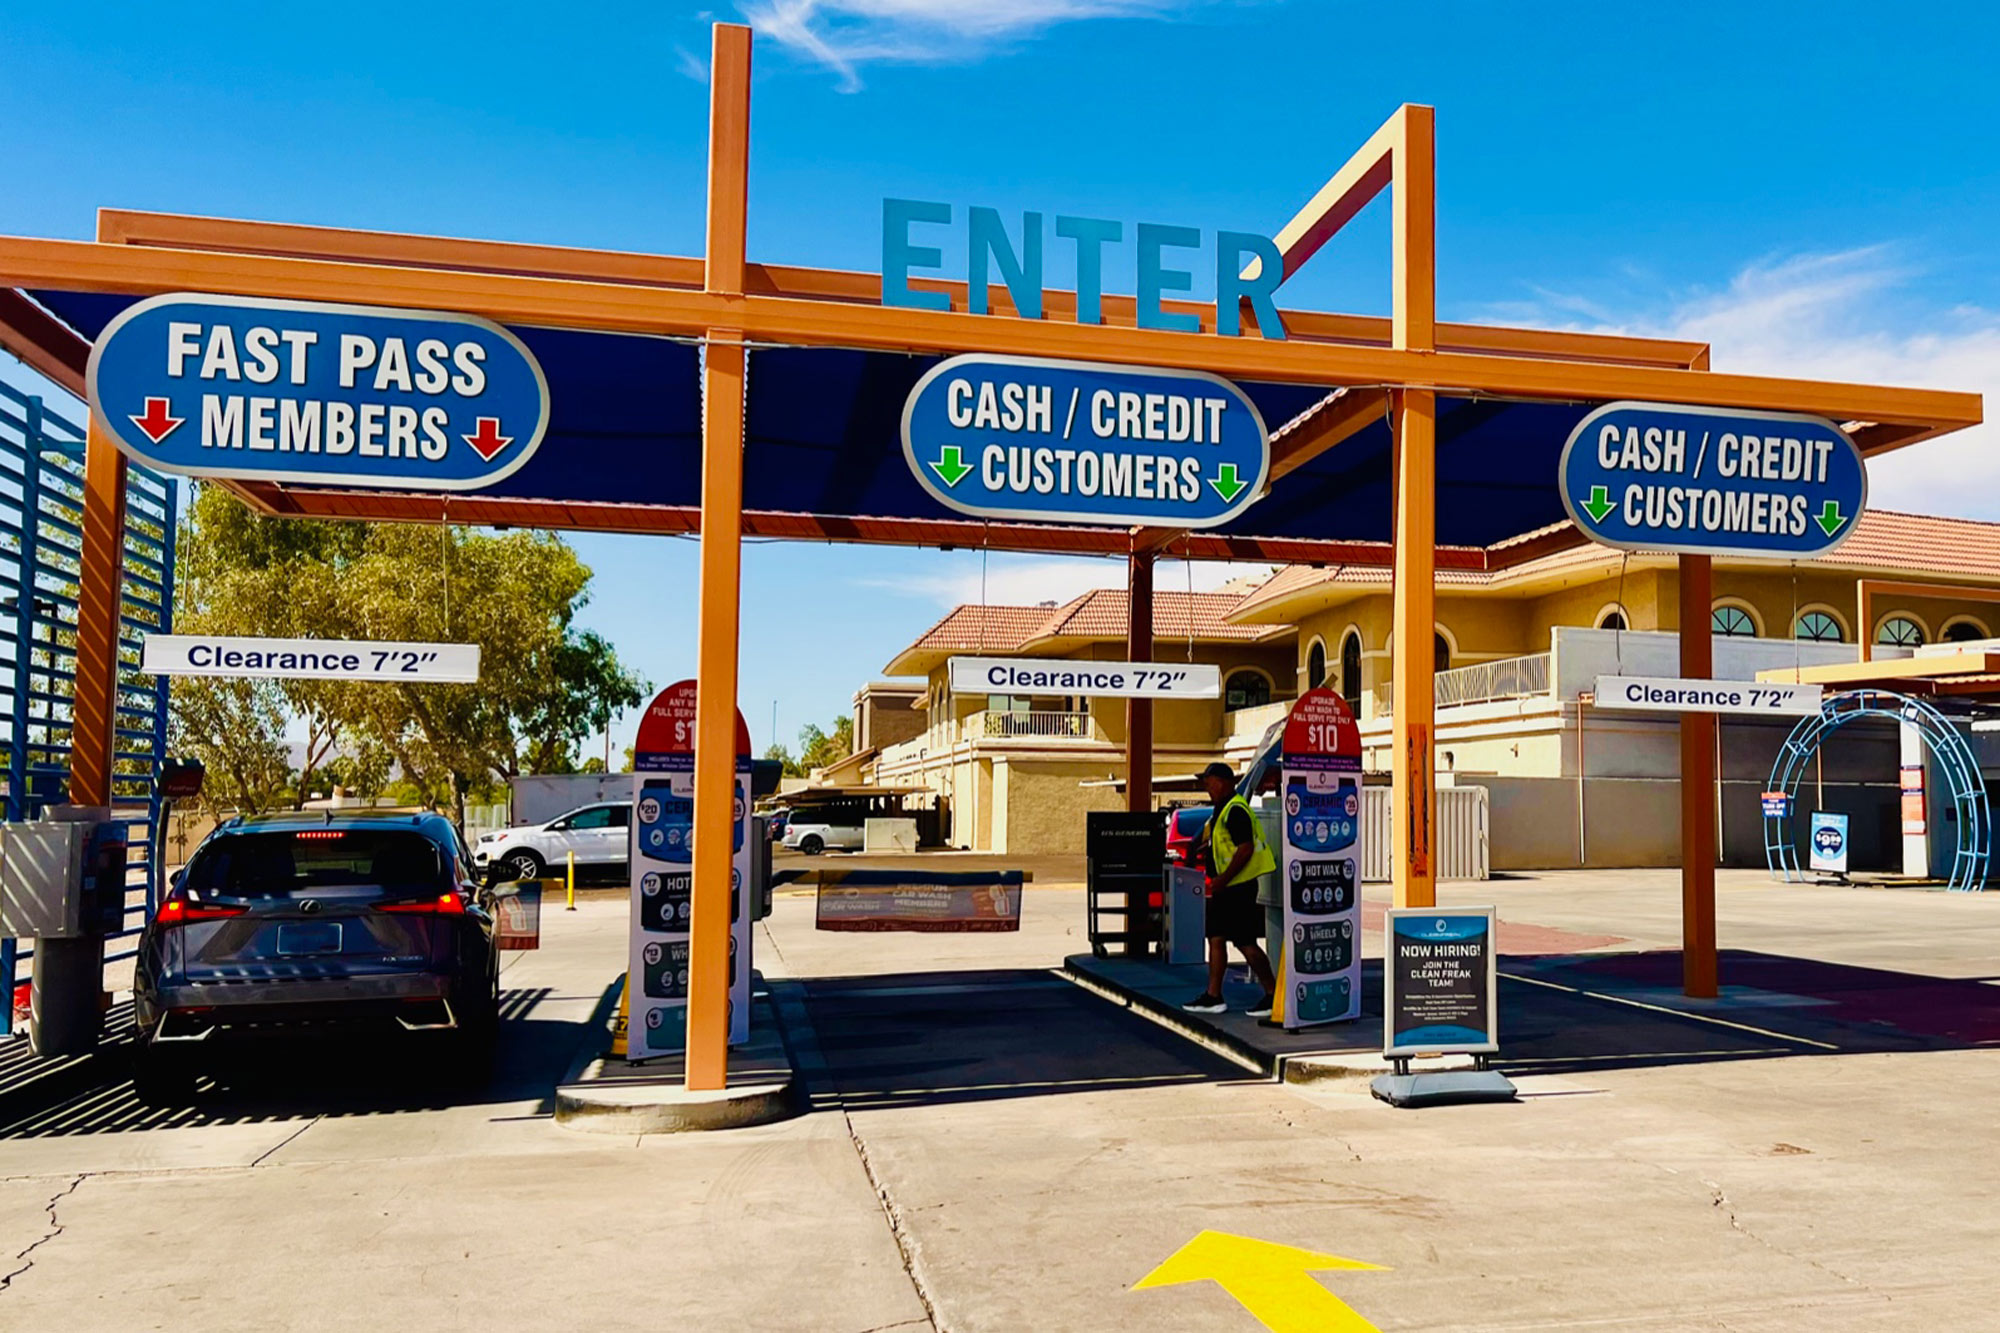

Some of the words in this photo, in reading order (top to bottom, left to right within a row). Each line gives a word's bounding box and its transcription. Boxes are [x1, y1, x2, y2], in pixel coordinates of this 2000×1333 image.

[881, 197, 1287, 340] ENTER
[167, 322, 318, 385] FAST
[339, 333, 487, 397] PASS
[947, 378, 1052, 433] CASH
[1063, 387, 1079, 438] /
[1091, 388, 1227, 444] CREDIT
[201, 394, 449, 461] MEMBERS
[1598, 423, 1685, 473] CASH
[1693, 431, 1709, 479] /
[1717, 433, 1834, 483] CREDIT
[982, 444, 1200, 502] CUSTOMERS
[1623, 484, 1807, 536] CUSTOMERS
[187, 645, 360, 672] Clearance
[987, 666, 1125, 689] Clearance
[669, 698, 686, 707] ANY
[1310, 696, 1336, 706] UPGRADE
[1625, 684, 1742, 707] Clearance
[653, 707, 672, 718] FULL
[1304, 704, 1316, 713] ANY
[1316, 706, 1333, 714] WASH
[1333, 707, 1342, 715] TO
[1293, 712, 1307, 722] FULL
[1307, 713, 1326, 723] SERVE
[1326, 715, 1337, 724] FOR
[1337, 716, 1351, 726] ONLY
[675, 719, 697, 750] $1
[1308, 724, 1338, 753] $10
[641, 804, 657, 815] $20
[1305, 864, 1321, 877] HOT
[1322, 864, 1340, 876] WAX
[667, 877, 691, 890] HOT
[892, 890, 915, 898] CAR
[918, 891, 952, 900] WASH
[822, 902, 845, 912] CAR
[847, 902, 881, 912] WASH
[894, 899, 949, 908] MEMBERS
[1310, 927, 1337, 941] WHEELS
[1400, 945, 1432, 958] NOW
[1434, 944, 1481, 958] HIRING!
[1422, 961, 1443, 969] JOIN
[1443, 960, 1460, 969] THE
[1410, 969, 1440, 980] CLEAN
[1442, 969, 1472, 979] FREAK
[1428, 979, 1454, 988] TEAM!
